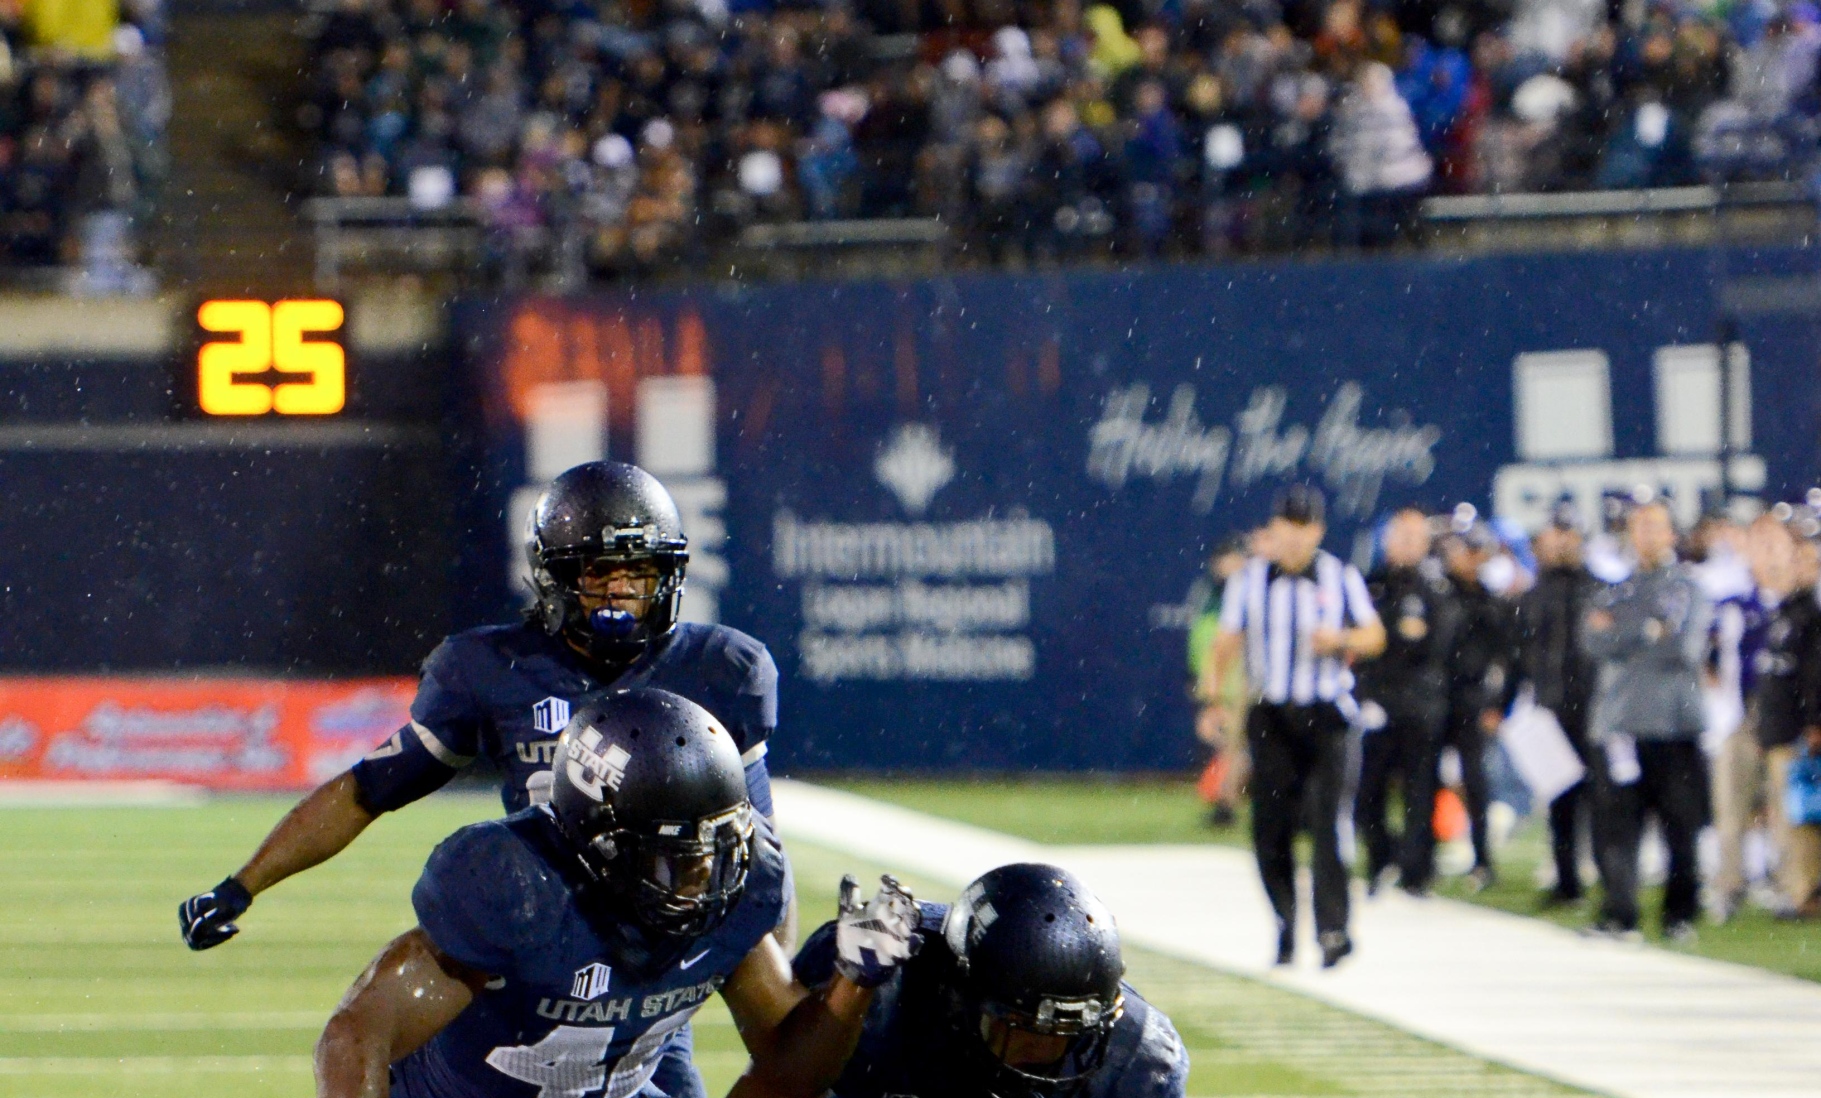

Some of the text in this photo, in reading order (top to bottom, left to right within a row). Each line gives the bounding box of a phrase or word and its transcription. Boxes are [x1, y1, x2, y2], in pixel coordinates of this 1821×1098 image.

[198, 299, 345, 414] 25
[774, 509, 1054, 577] Intermountain
[801, 631, 1033, 686] Sports Medicine
[516, 740, 560, 764] UT
[568, 738, 626, 793] STATE
[658, 825, 682, 836] NIKE
[536, 997, 632, 1022] UTAH
